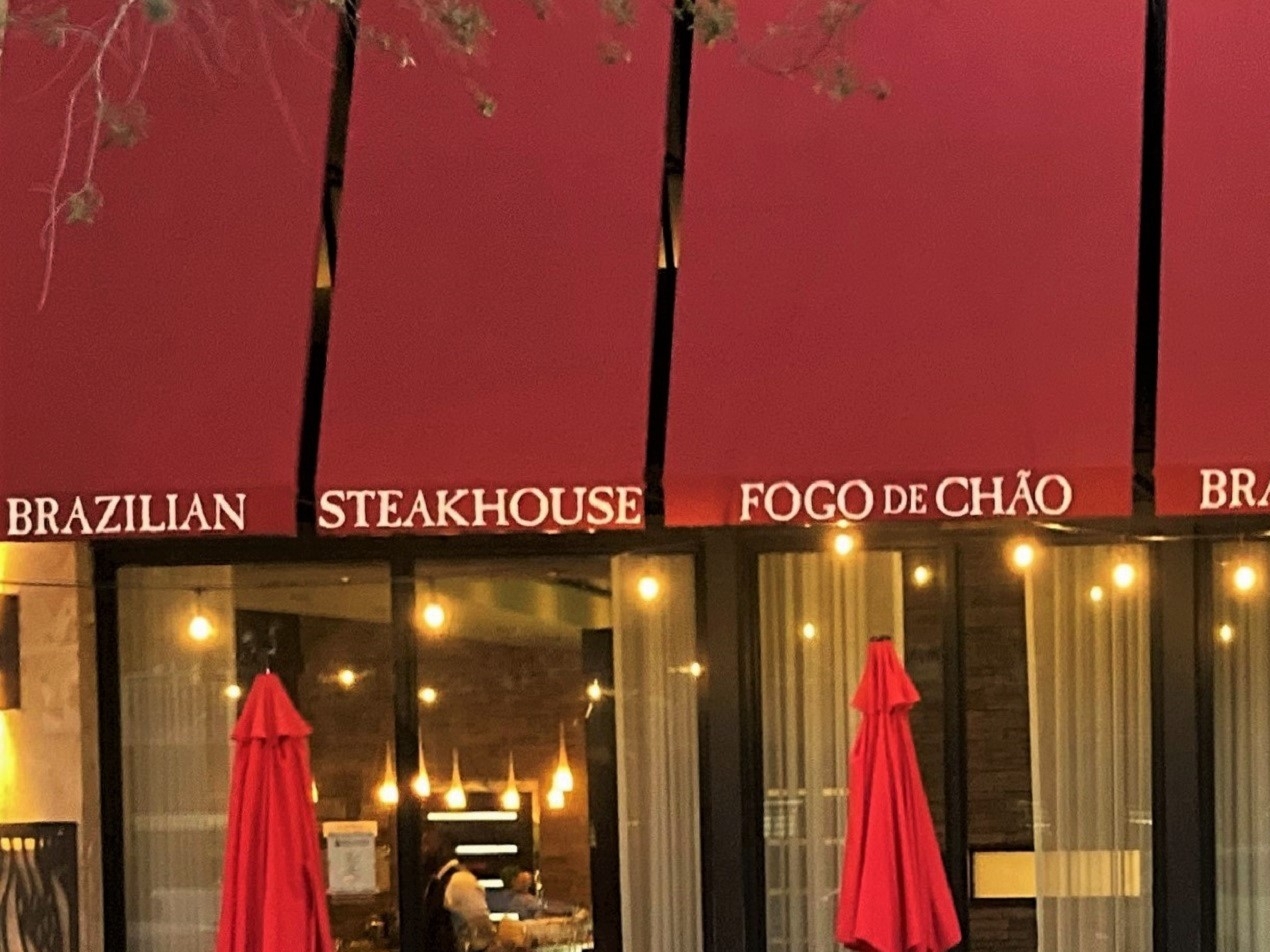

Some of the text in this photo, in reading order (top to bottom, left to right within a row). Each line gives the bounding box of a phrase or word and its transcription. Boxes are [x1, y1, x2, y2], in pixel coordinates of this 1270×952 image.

[7, 493, 247, 536] BRAZILIAN
[317, 486, 643, 530] STEAKHOUSE
[739, 470, 1073, 522] FOGO DE CHÃO
